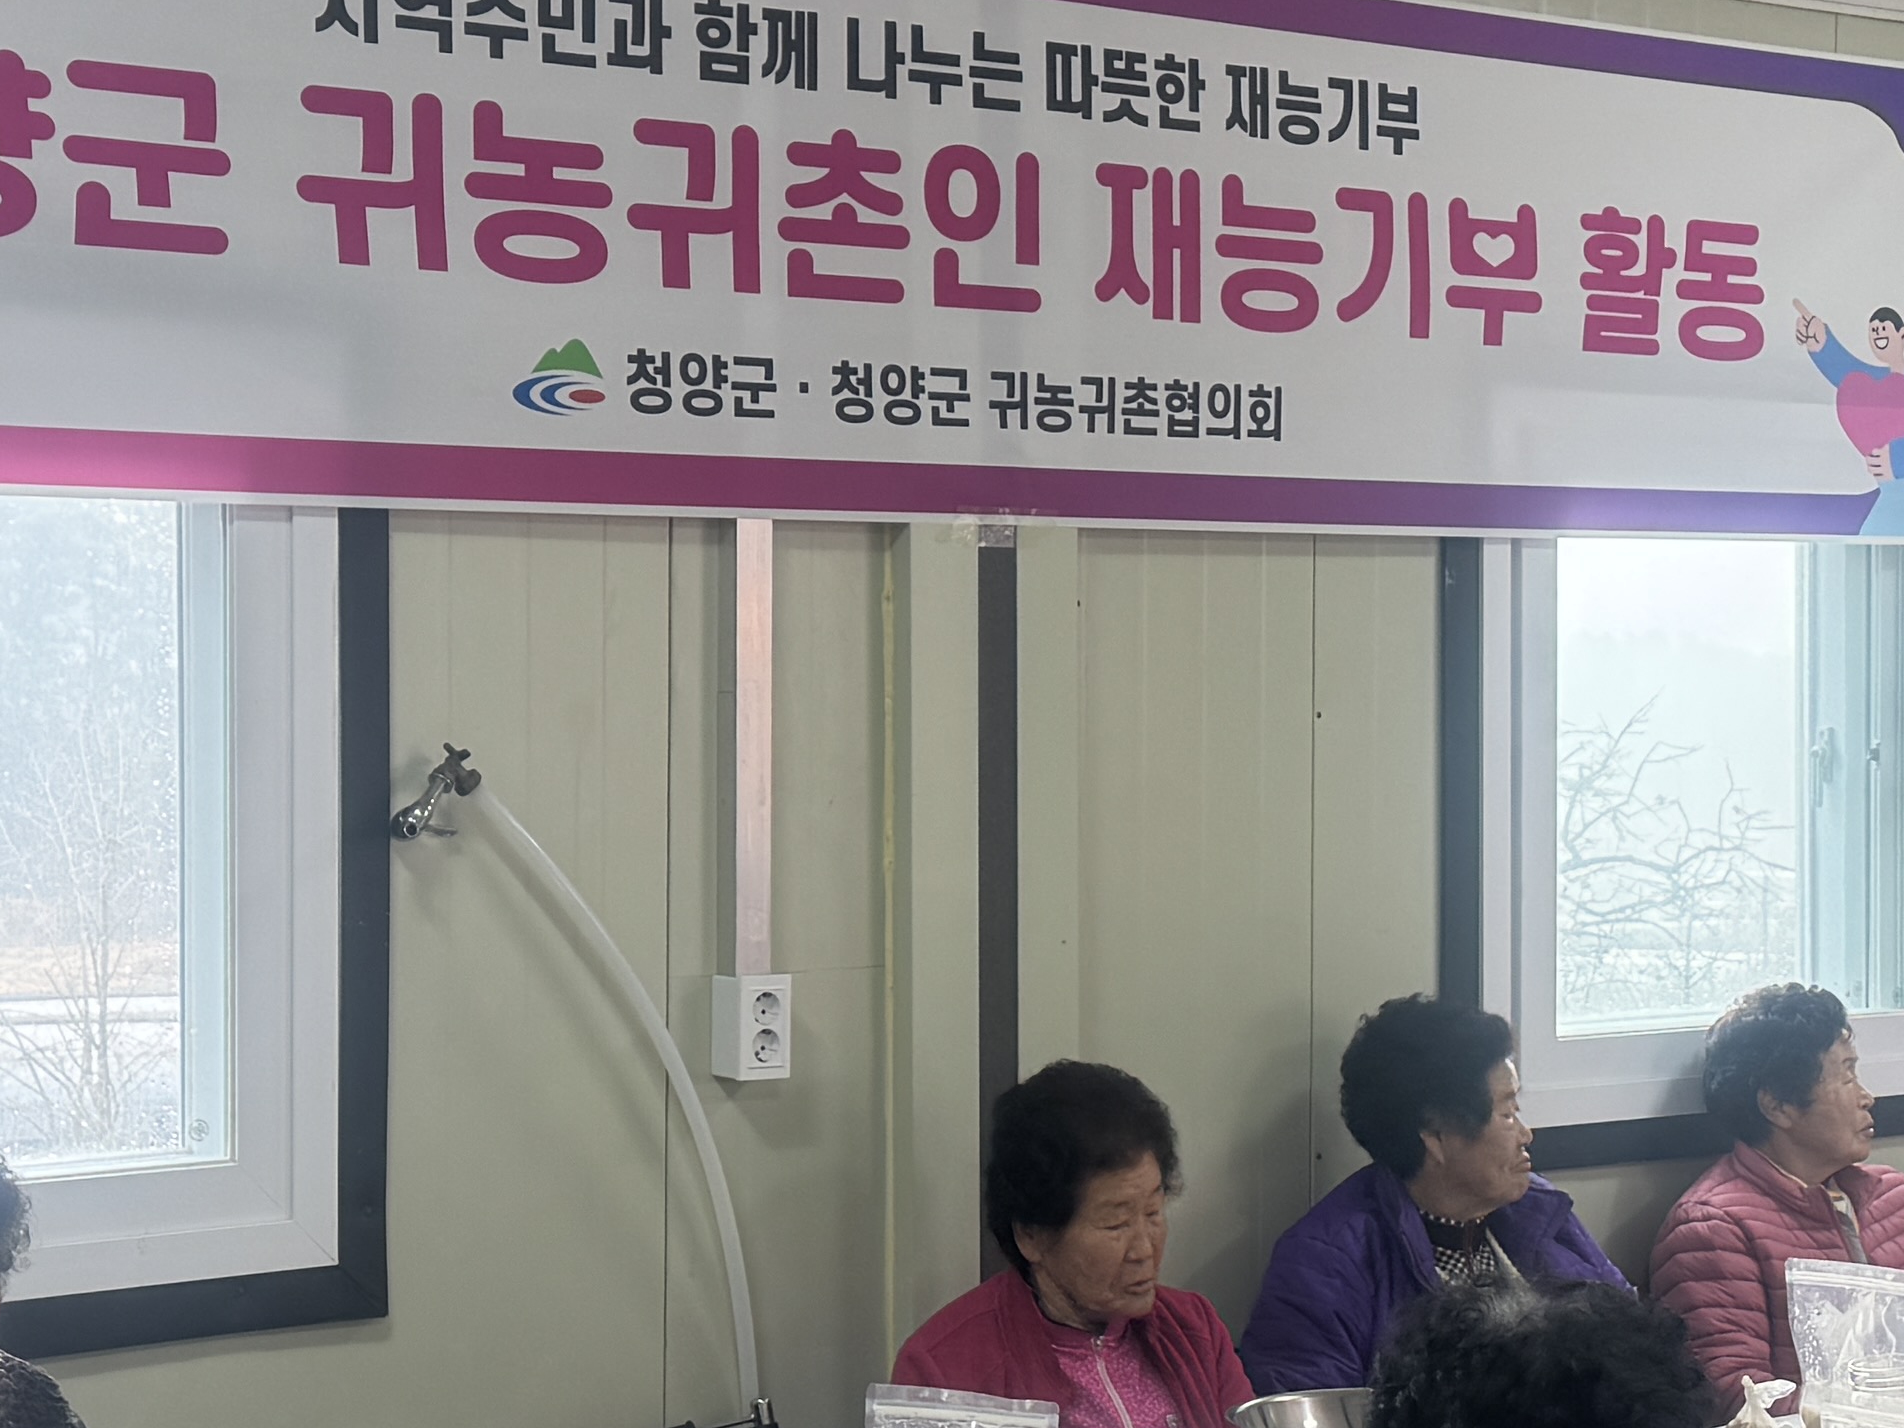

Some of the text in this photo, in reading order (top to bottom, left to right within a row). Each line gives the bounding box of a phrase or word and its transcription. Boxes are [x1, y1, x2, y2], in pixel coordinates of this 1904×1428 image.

[845, 15, 1025, 114] 나누는
[1044, 39, 1207, 135] 따뜻한
[1224, 61, 1421, 158] 재능기부
[296, 84, 1042, 315] 귀농귀촌인
[1093, 161, 1544, 347] 재능기부
[1579, 206, 1766, 362] 활동
[625, 346, 778, 420] 청양군
[830, 358, 972, 429] 청양군
[987, 369, 1284, 444] 귀농귀촌협의회
